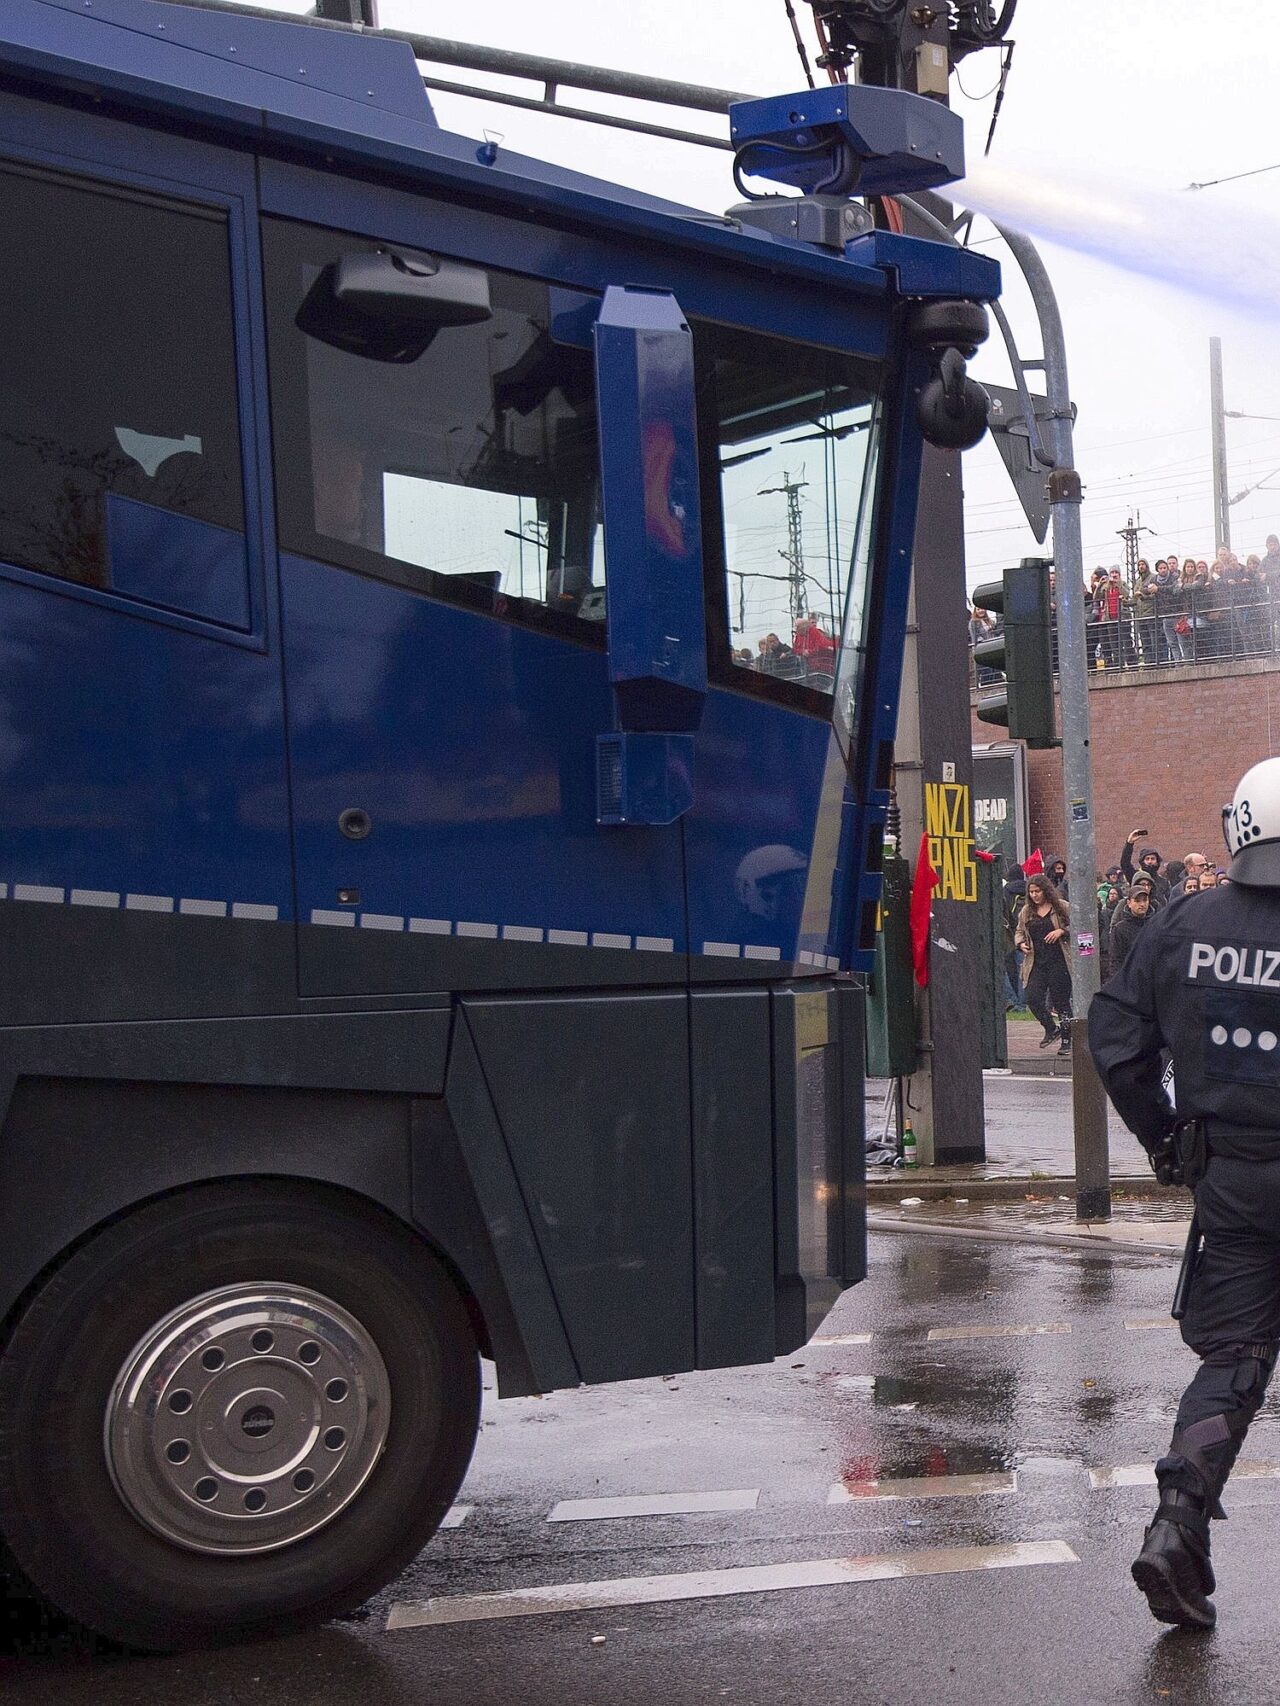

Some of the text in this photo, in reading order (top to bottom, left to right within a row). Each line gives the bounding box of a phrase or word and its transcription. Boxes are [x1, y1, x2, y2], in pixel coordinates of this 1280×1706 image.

[925, 783, 969, 838] NAZI
[974, 798, 1007, 821] DEAD
[1232, 800, 1252, 832] 13
[928, 838, 978, 902] RAUS
